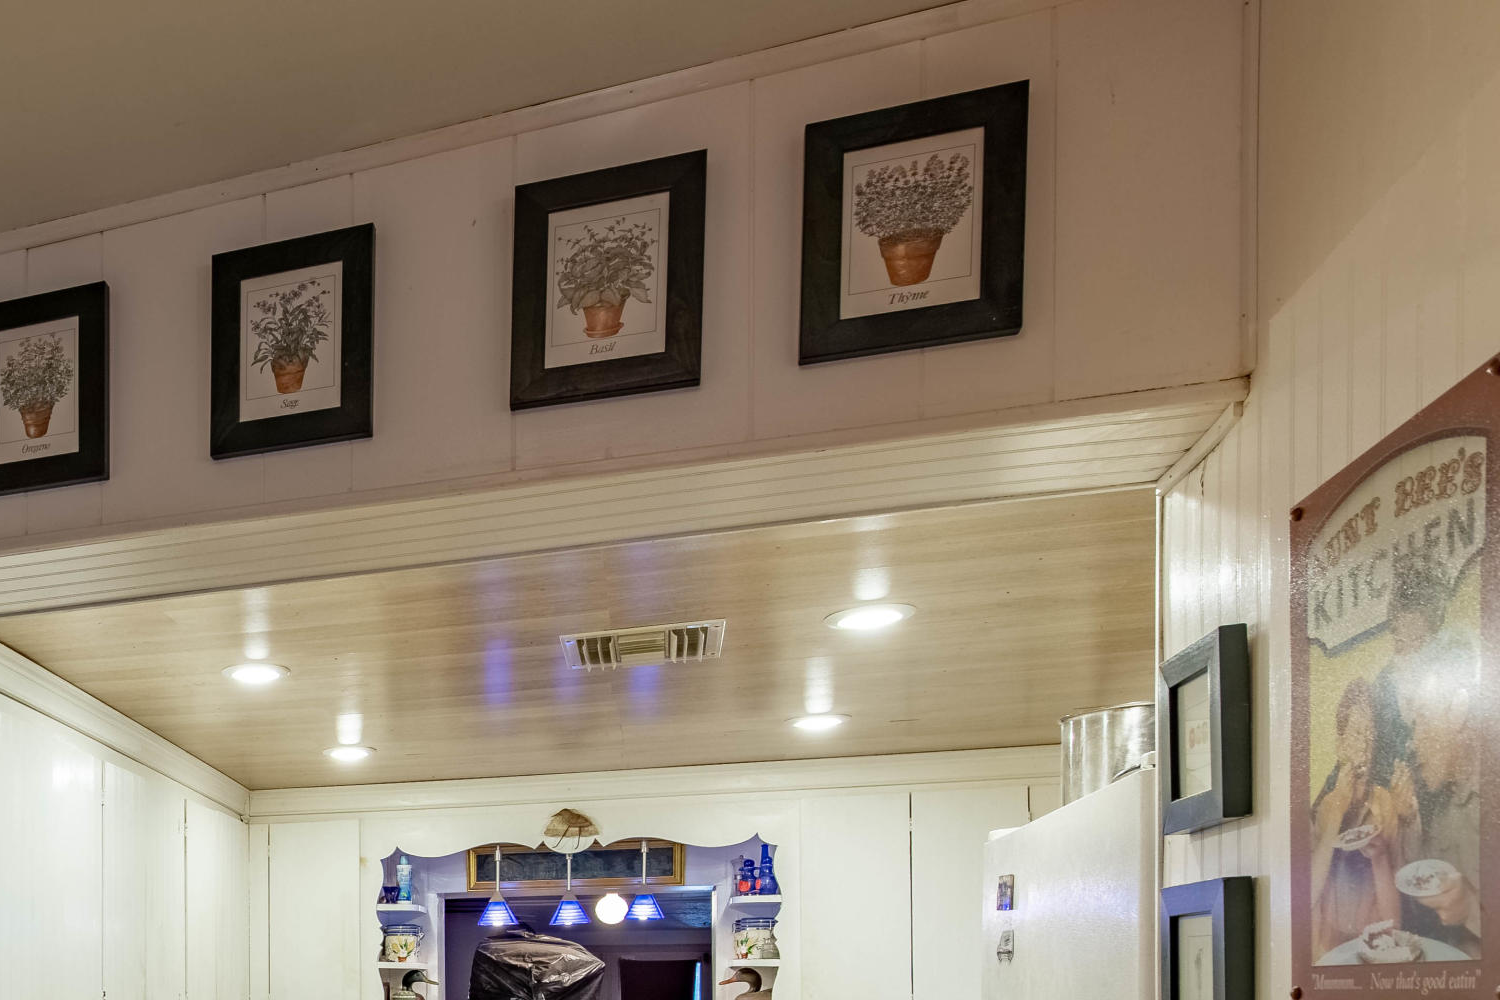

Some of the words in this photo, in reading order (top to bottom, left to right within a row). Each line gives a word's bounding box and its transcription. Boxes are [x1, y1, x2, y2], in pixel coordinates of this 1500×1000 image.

[889, 291, 929, 305] Thyme
[589, 341, 617, 354] Basil
[1394, 446, 1485, 518] BEE'S
[1370, 972, 1395, 990] Now
[1396, 971, 1420, 989] that's
[1421, 970, 1446, 995] good
